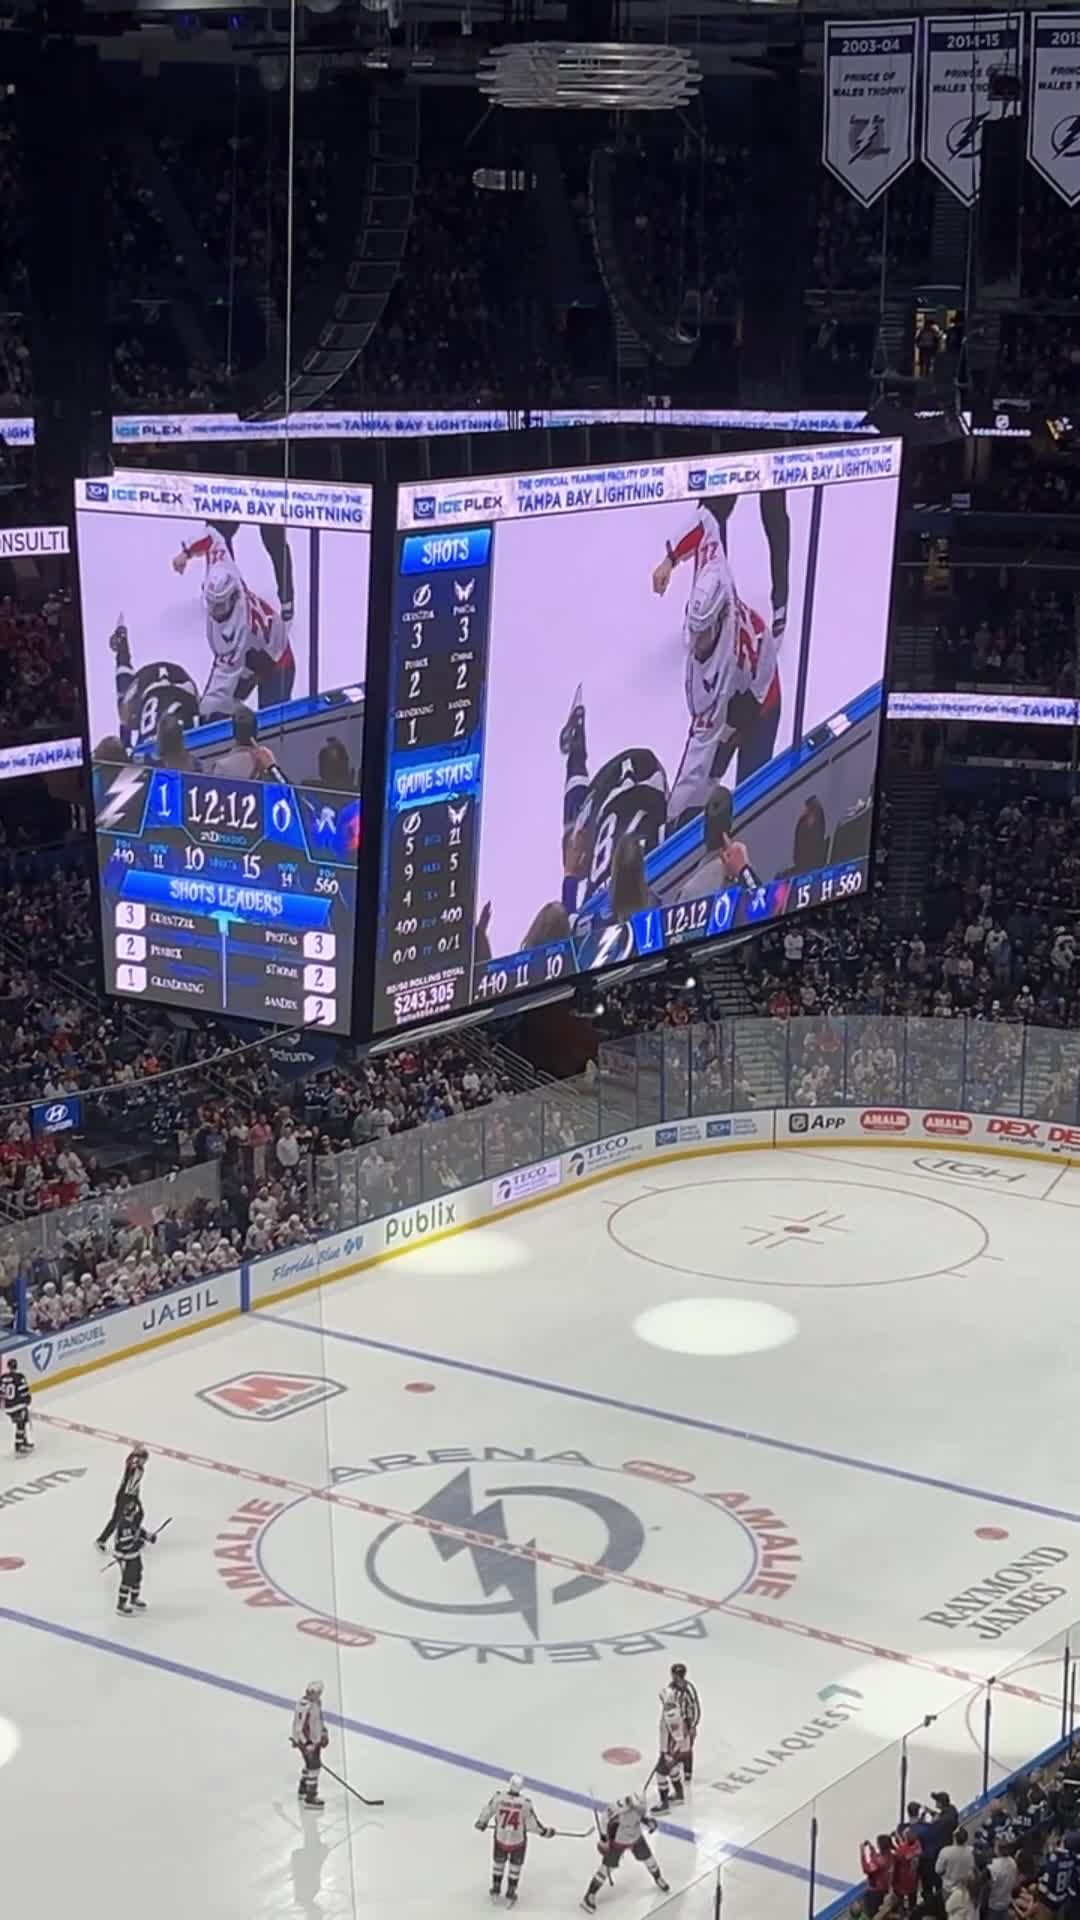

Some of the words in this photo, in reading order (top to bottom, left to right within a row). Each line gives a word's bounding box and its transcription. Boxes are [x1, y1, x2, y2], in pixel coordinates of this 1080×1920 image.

[841, 38, 900, 54] 2003-04
[843, 72, 879, 82] PRINCE
[882, 71, 896, 81] OF
[933, 84, 966, 93] WALES
[833, 87, 865, 97] WALES
[867, 85, 906, 96] TROPHY
[343, 418, 391, 431] TAMPA
[395, 418, 422, 431] BAY
[428, 417, 506, 431] LIGHTNING
[772, 467, 808, 485] TAMPA
[811, 464, 834, 481] BAY
[836, 458, 892, 478] LIGHTNING
[193, 497, 242, 515] TAMPA
[247, 501, 275, 517] BAY
[280, 503, 363, 523] LIGHTNING
[517, 491, 562, 513] TAMPA
[566, 488, 592, 508] BAY
[596, 481, 664, 504] LIGHTNING
[421, 536, 470, 567] SHOTS
[411, 622, 423, 649] 3
[458, 616, 469, 643] 3
[408, 670, 421, 699] 2
[455, 662, 468, 690] 2
[1022, 703, 1078, 720] TAMPA
[407, 717, 418, 745] 1
[453, 709, 466, 737] 2
[28, 747, 73, 767] TAMPA
[397, 767, 434, 797] GAME
[435, 761, 473, 789] STATS
[159, 783, 172, 817] 1
[188, 786, 259, 830] 12:12
[271, 799, 292, 832] 0
[405, 836, 415, 856] 5
[448, 827, 461, 846] 21
[153, 853, 165, 869] 11
[184, 845, 205, 871] 10
[242, 853, 262, 879] 15
[404, 863, 414, 881] 9
[449, 852, 459, 872] 5
[170, 879, 216, 905] SHOTS
[218, 886, 283, 916] LEADERS
[448, 879, 456, 898] 1
[125, 904, 134, 924] 3
[126, 936, 136, 956] 2
[314, 934, 324, 954] 3
[392, 945, 417, 965] 0/0
[438, 933, 460, 953] 0/1
[515, 963, 529, 988] 11
[544, 953, 563, 981] 10
[642, 911, 654, 949] 1
[664, 900, 708, 937] 12:12
[714, 891, 731, 928] 0
[796, 883, 811, 909] 15
[127, 968, 136, 987] 1
[314, 968, 325, 987] 2
[442, 966, 465, 979] TOTAL
[315, 999, 325, 1020] 2
[393, 982, 455, 1016] $243,305
[863, 1113, 907, 1127] AMALIE
[925, 1117, 969, 1131] AMALIE
[986, 1119, 1040, 1138] DEX
[585, 1136, 629, 1159] TECO
[513, 1166, 547, 1185] TECO
[272, 1254, 315, 1281] Florida
[143, 1288, 219, 1331] JABIL
[56, 1325, 105, 1348] FANDUEL
[330, 1446, 592, 1484] ARENA
[213, 1498, 296, 1608] AMALIE
[703, 1492, 802, 1600] AMALIE
[919, 1545, 1069, 1629] RAYMOND
[966, 1582, 1067, 1640] JAMES
[410, 1615, 708, 1665] ARENA
[711, 1703, 863, 1794] RELIAQUEST
[499, 1808, 520, 1831] 74
